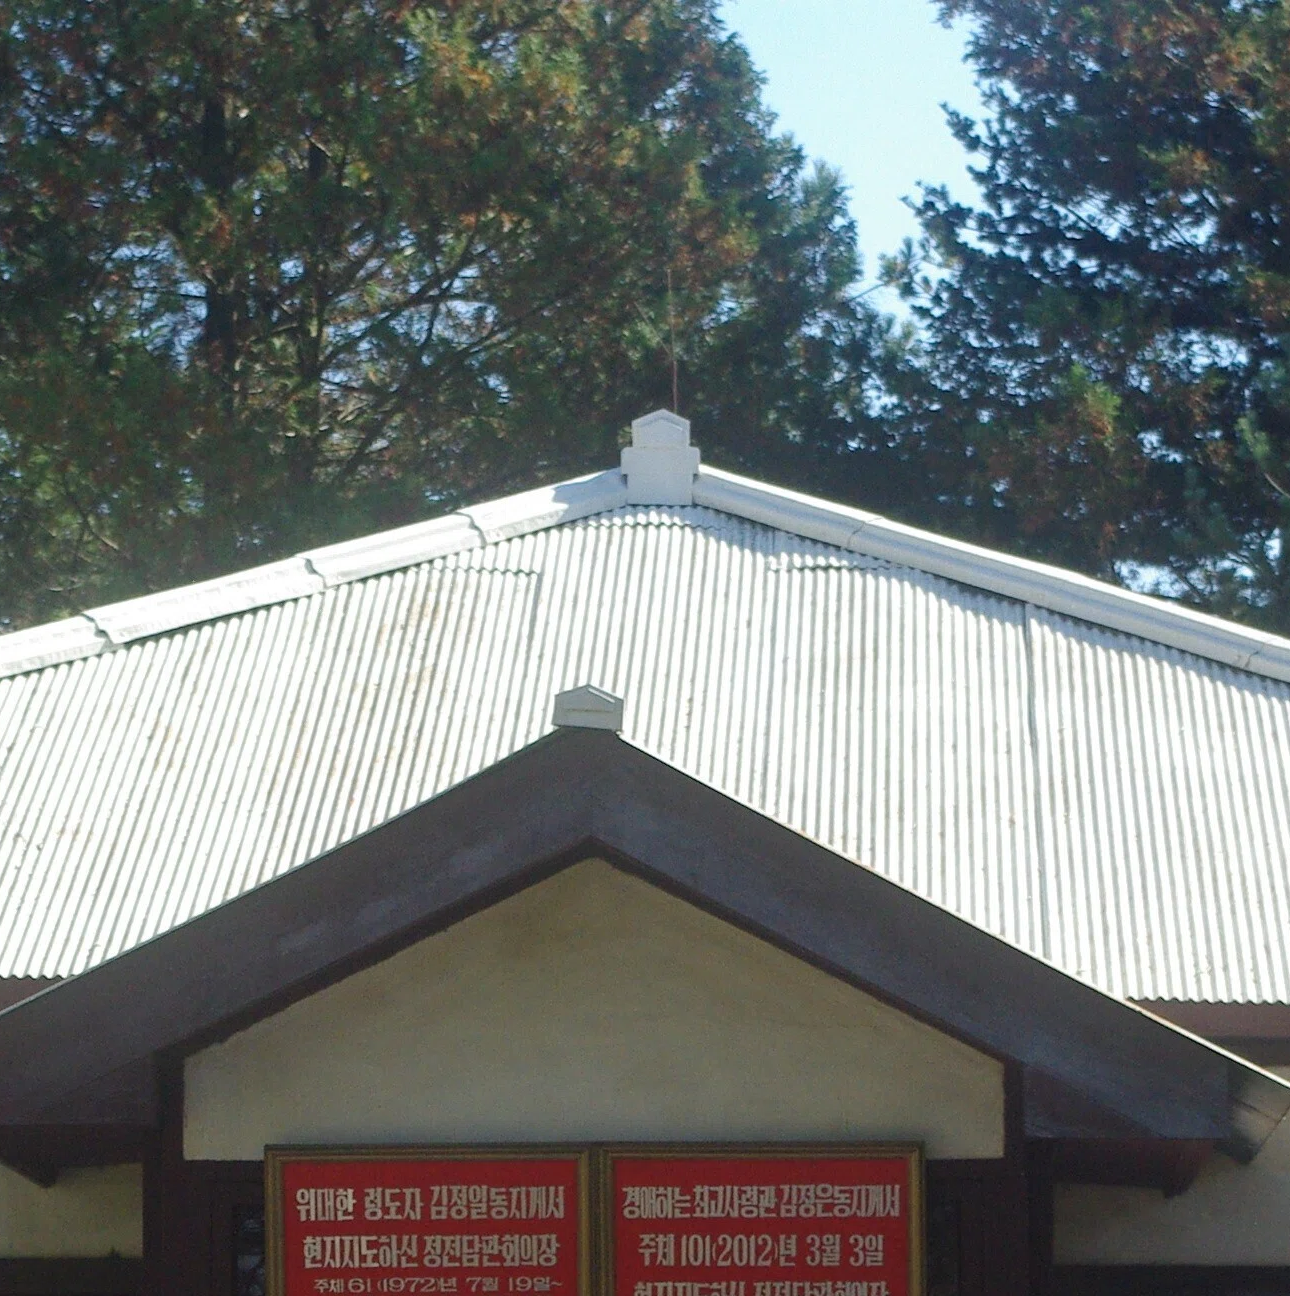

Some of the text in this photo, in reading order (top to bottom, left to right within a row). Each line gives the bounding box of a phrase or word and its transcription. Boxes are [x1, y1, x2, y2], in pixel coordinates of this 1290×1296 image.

[296, 1184, 565, 1222] 위대한 령도자 김정일동지께서
[621, 1183, 901, 1219] 경애하는 최고사령관 김정은동지께서
[303, 1234, 419, 1269] 현지지도하신
[806, 1233, 841, 1267] 3월
[849, 1233, 884, 1267] 3일
